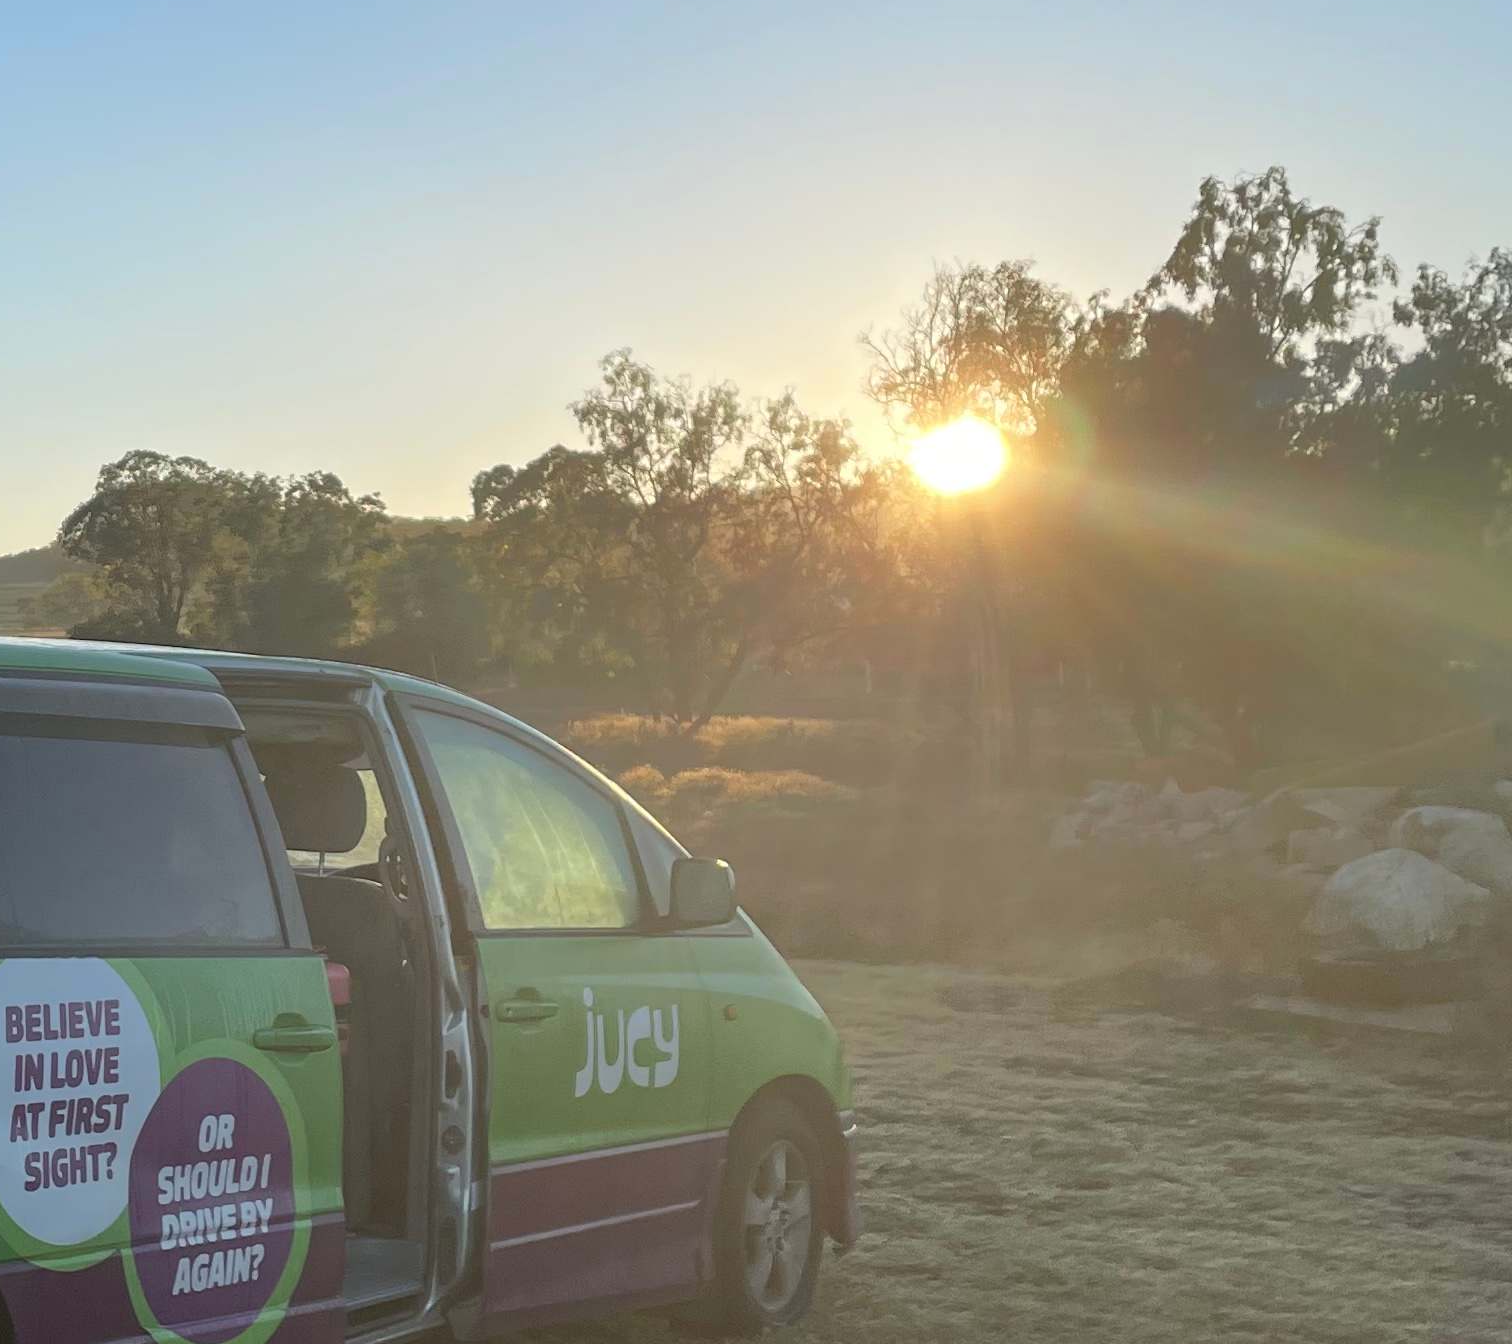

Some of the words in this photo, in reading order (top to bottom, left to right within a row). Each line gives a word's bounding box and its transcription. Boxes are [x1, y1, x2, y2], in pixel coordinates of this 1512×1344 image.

[5, 999, 121, 1044] BELIEVE
[574, 987, 680, 1098] jucy
[14, 1053, 45, 1092] IN
[50, 1047, 120, 1088] LOVE
[9, 1101, 44, 1143] AT
[48, 1094, 130, 1138] FIRST
[199, 1114, 236, 1152] OR
[24, 1143, 118, 1192] SIGHT?
[158, 1156, 258, 1204] SHOULD
[260, 1154, 272, 1189] I
[160, 1204, 237, 1251] DRIVE
[239, 1198, 274, 1235] BY
[172, 1244, 266, 1296] AGAIN?
